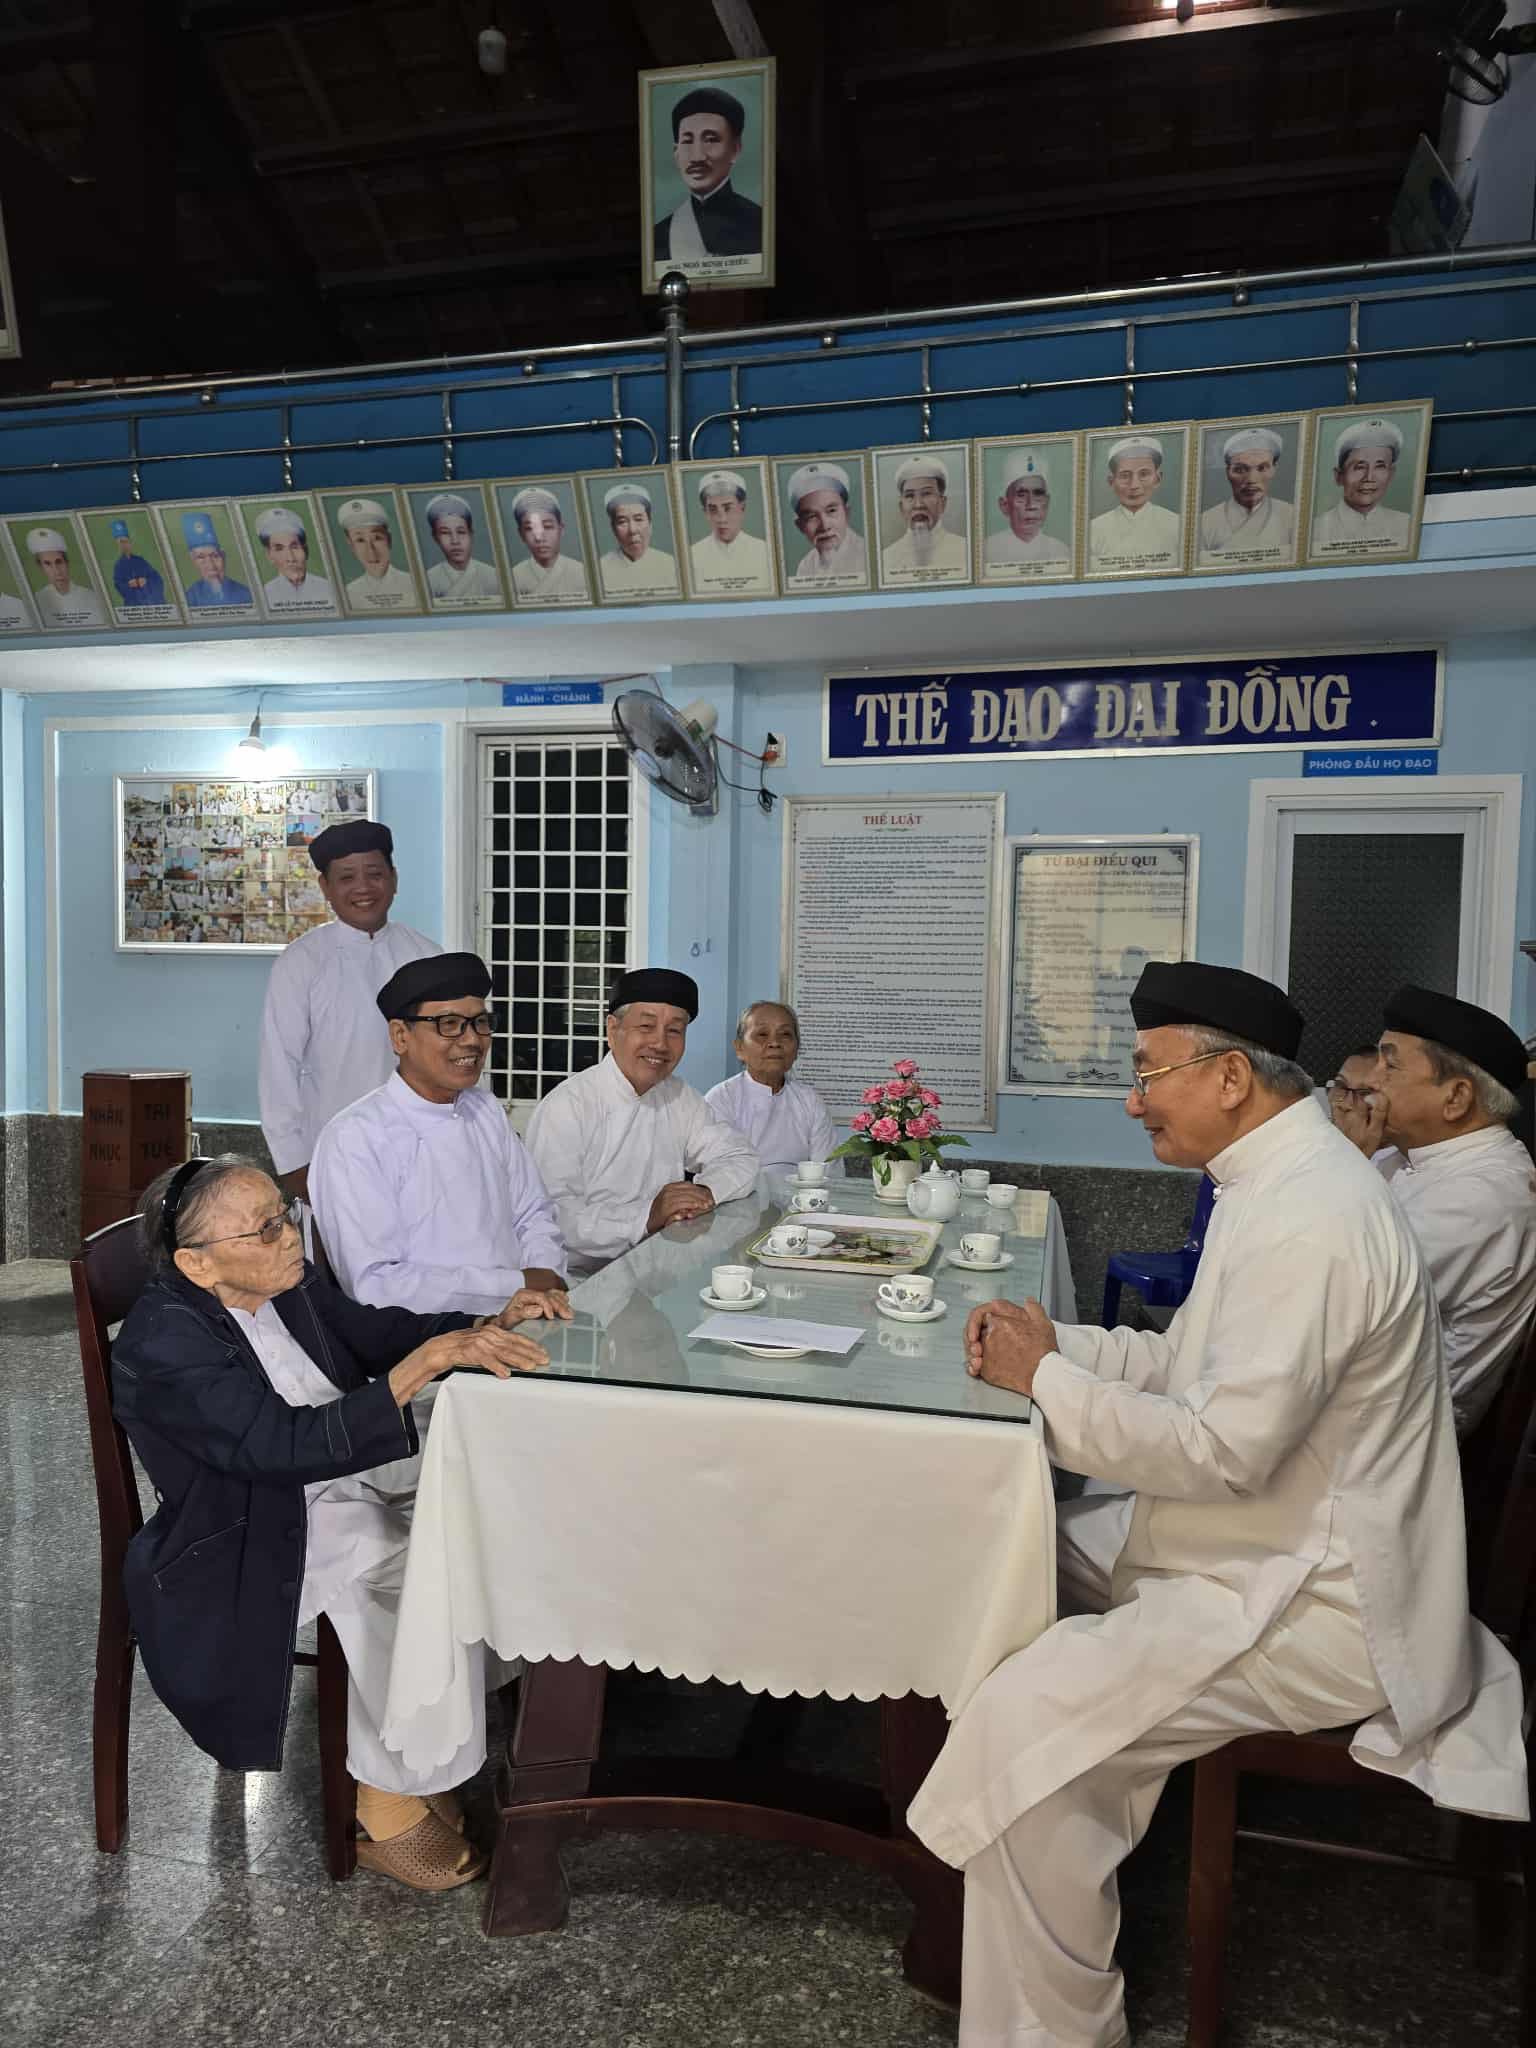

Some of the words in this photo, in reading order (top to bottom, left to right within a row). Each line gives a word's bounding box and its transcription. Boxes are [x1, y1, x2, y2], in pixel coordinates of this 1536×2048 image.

[855, 676, 951, 747] THẾ
[969, 686, 1062, 748] ĐẠO
[1093, 680, 1181, 743] ĐẠI
[1205, 665, 1351, 736] ĐỒNG
[1309, 758, 1352, 769] PHÒNG
[1131, 855, 1157, 868] QUI
